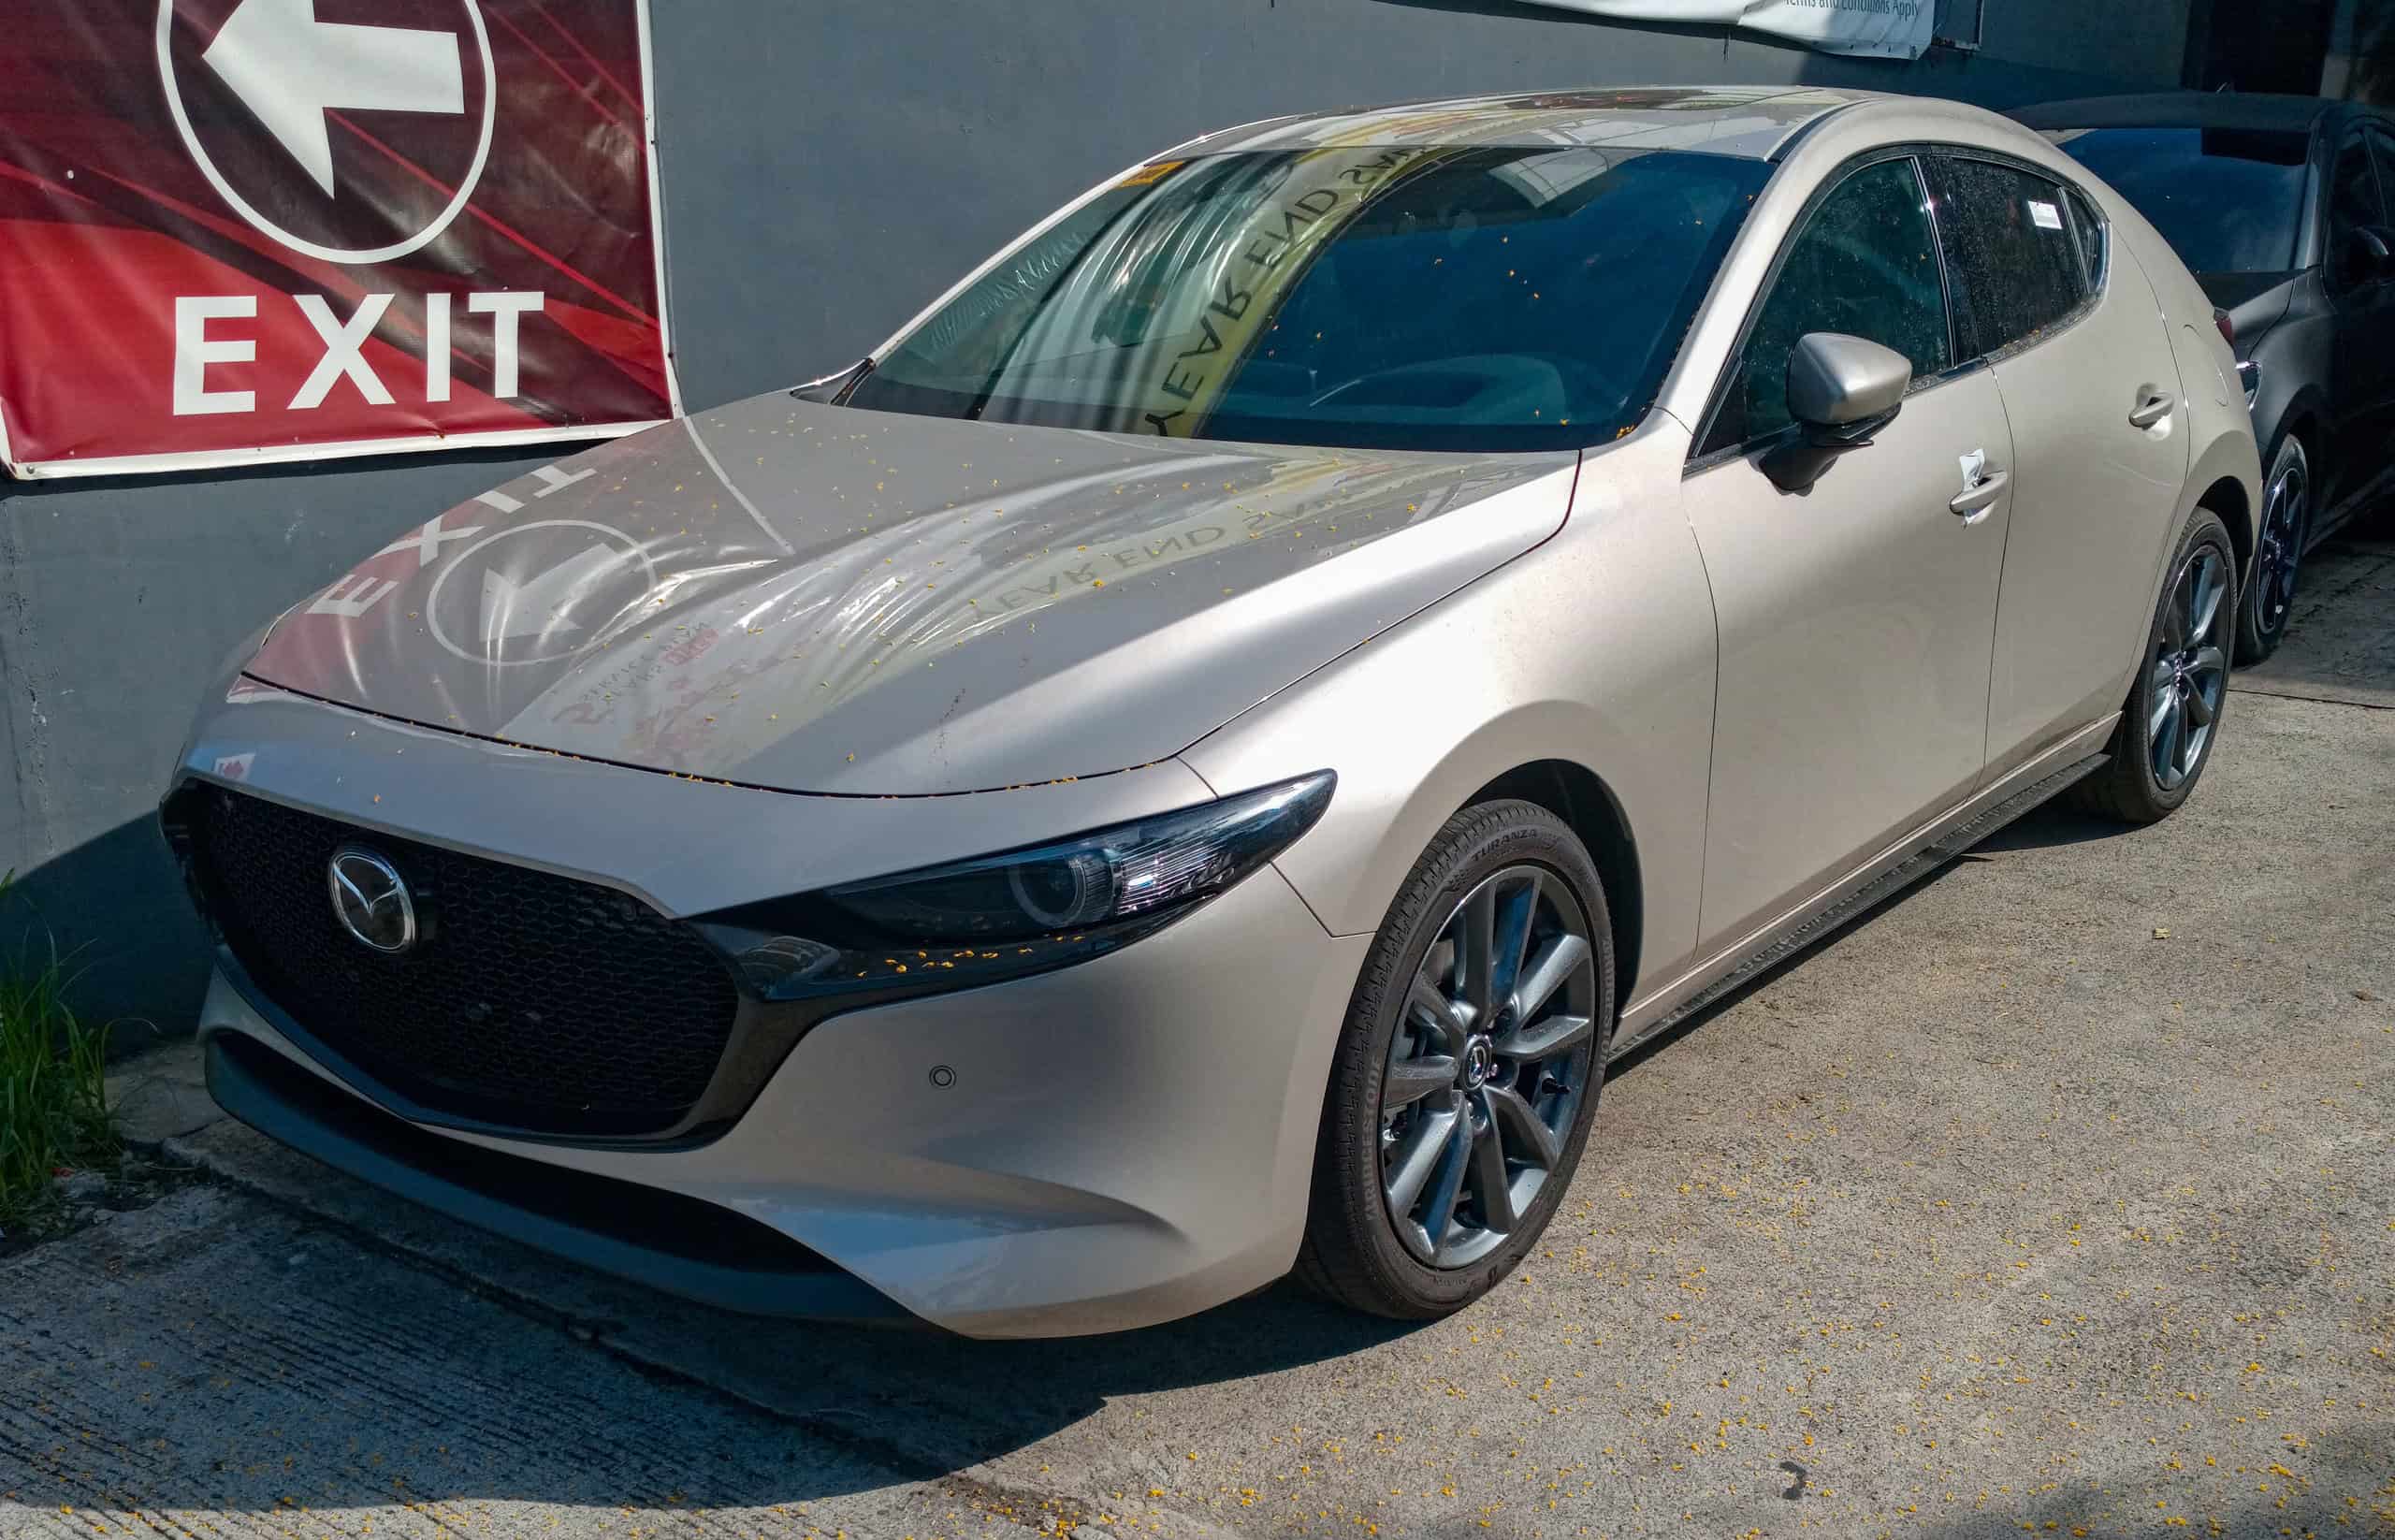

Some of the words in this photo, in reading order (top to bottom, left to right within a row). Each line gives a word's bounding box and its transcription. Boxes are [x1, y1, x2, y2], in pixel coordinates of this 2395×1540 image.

[1892, 0, 1920, 22] Apply
[173, 291, 544, 416] EXIT
[1470, 829, 1537, 862] TURANZA
